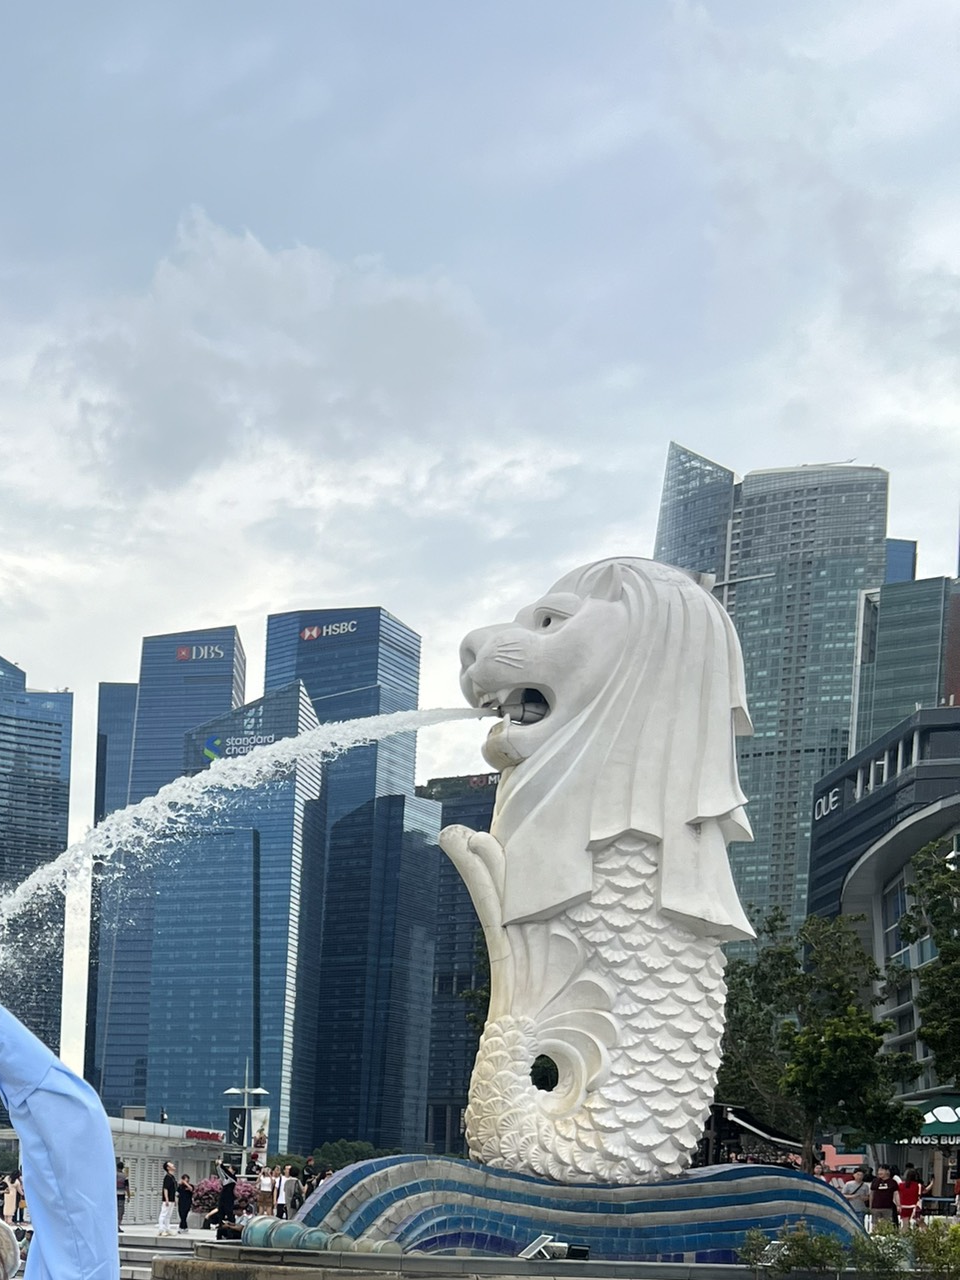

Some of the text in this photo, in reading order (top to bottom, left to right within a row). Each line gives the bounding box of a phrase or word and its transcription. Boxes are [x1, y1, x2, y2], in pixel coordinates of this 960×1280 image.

[322, 621, 357, 637] HSBC
[191, 645, 224, 660] DBS
[225, 734, 275, 747] standard
[815, 788, 839, 820] OUE
[911, 1136, 939, 1145] MOS
